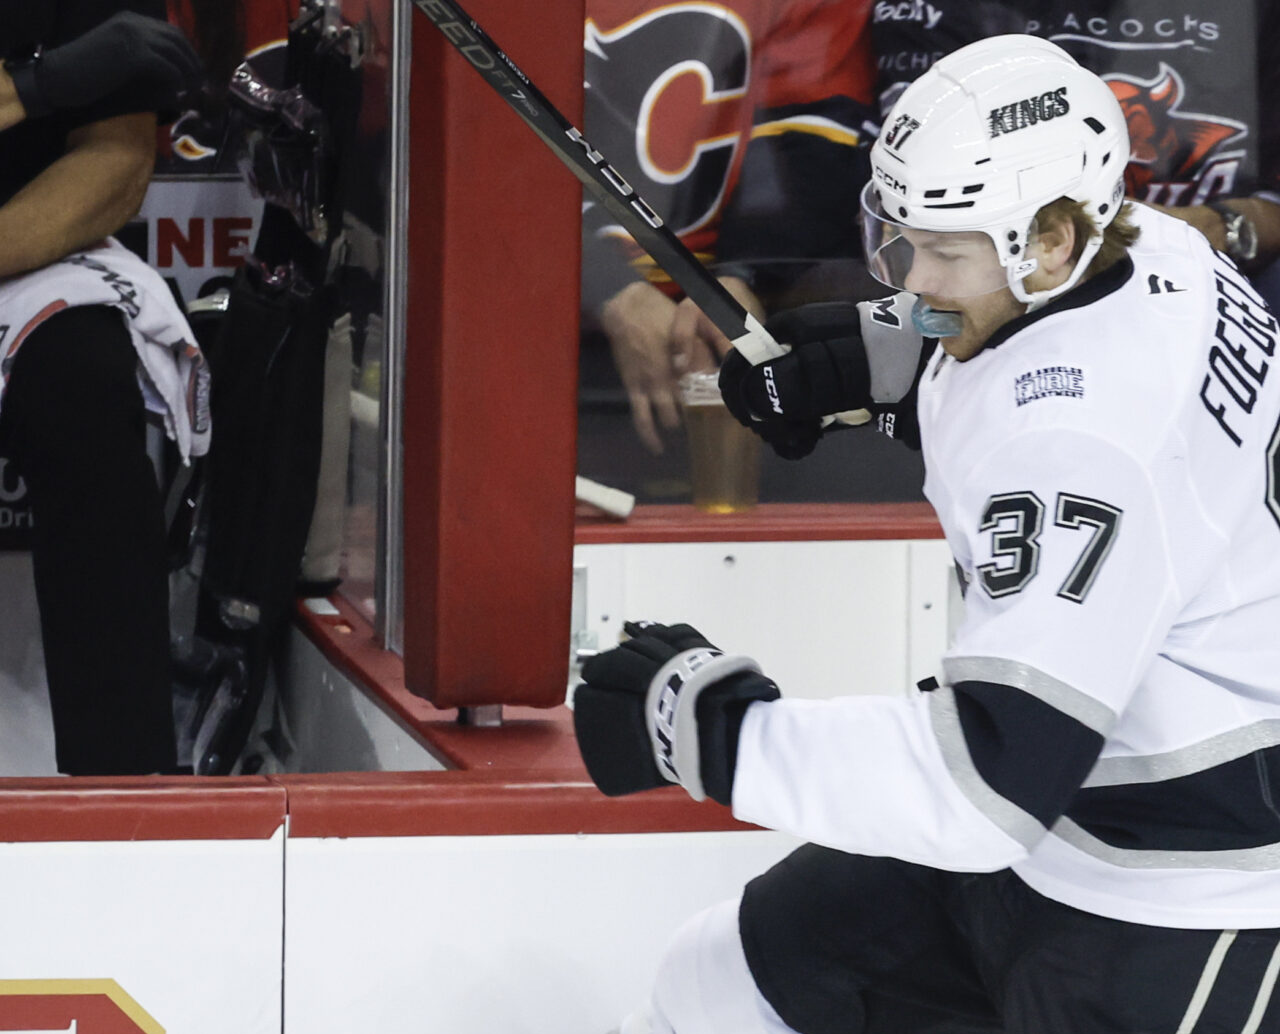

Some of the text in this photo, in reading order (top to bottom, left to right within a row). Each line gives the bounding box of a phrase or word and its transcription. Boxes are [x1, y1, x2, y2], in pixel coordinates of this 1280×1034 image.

[885, 113, 922, 151] 37
[986, 86, 1071, 139] KINGS
[875, 165, 908, 196] CCM
[763, 365, 784, 415] CCM
[1014, 372, 1084, 403] FIRE
[977, 489, 1124, 605] 37
